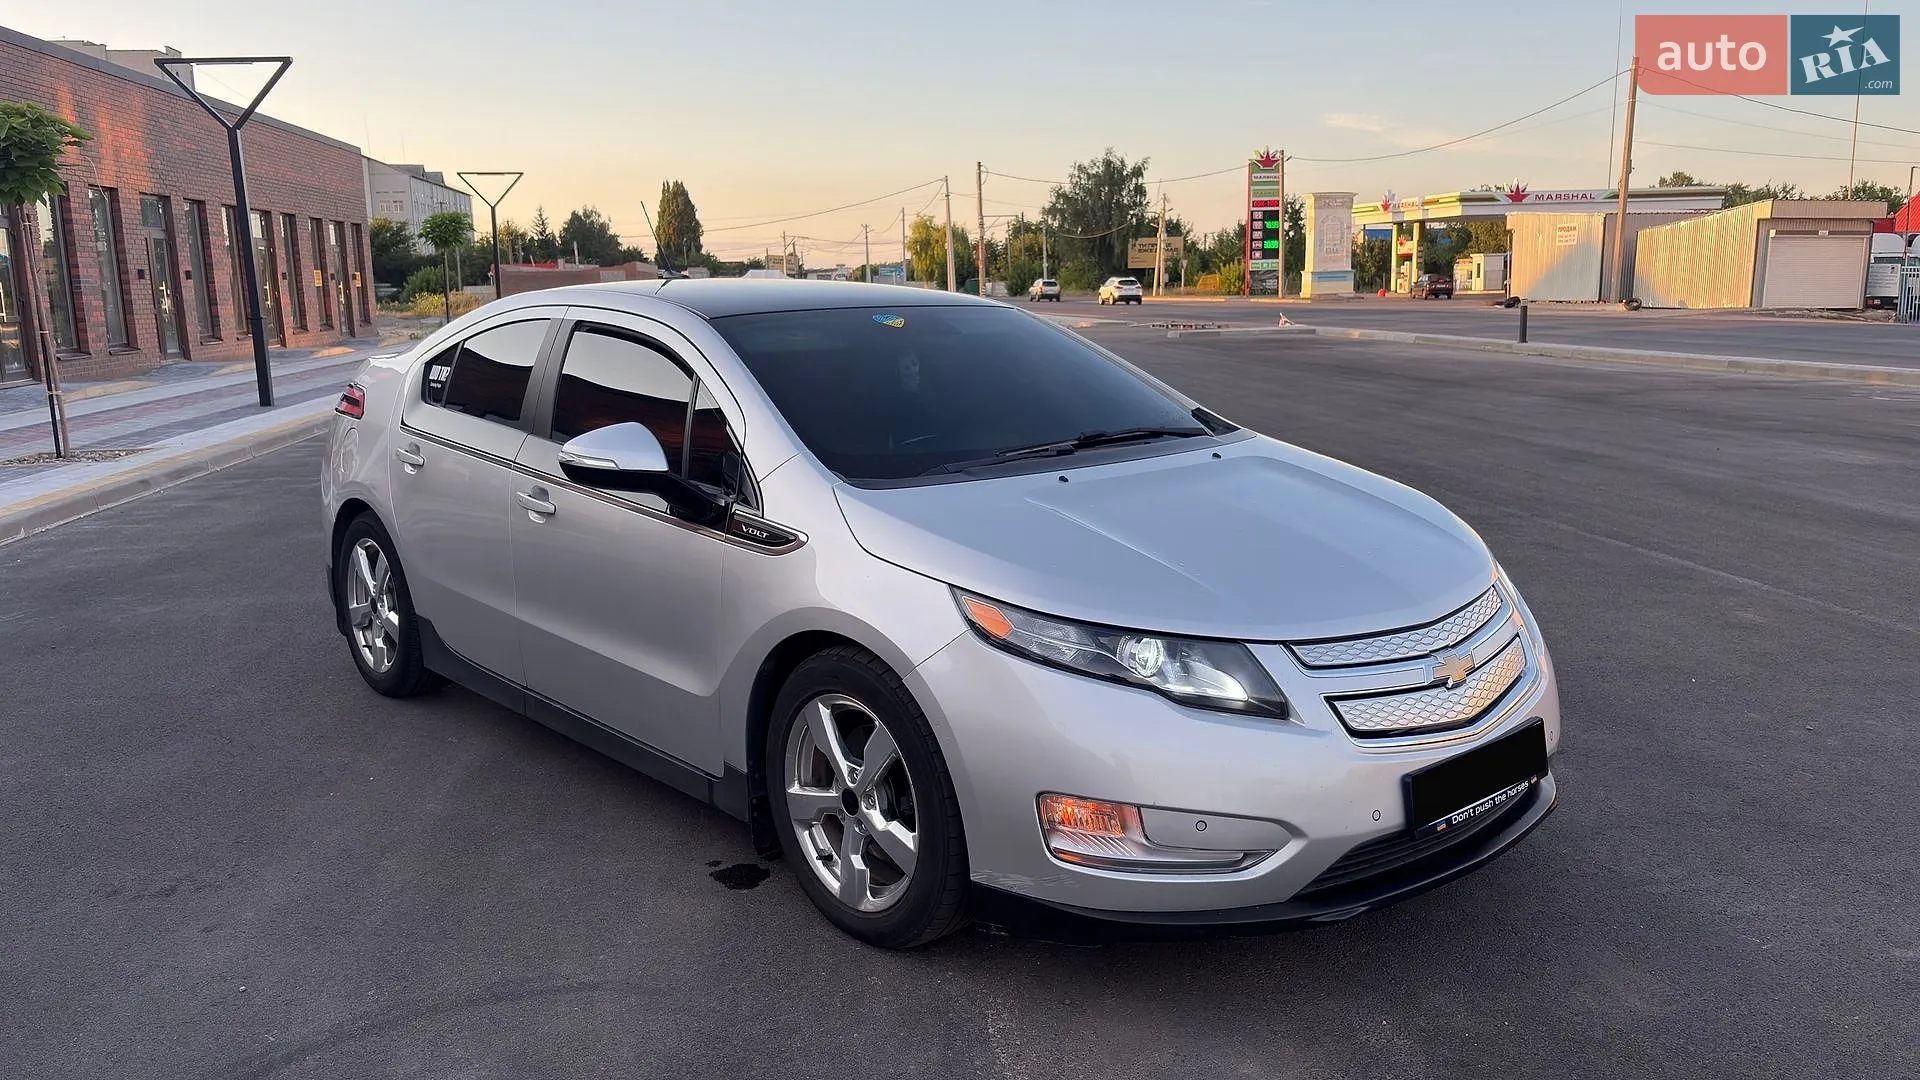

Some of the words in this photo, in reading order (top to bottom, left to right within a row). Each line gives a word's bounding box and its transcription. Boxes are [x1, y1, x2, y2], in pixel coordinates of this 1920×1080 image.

[1534, 192, 1596, 201] MARSHAL
[741, 524, 769, 539] VOLT
[1451, 809, 1474, 825] Don't
[1475, 800, 1494, 816] push
[1495, 793, 1507, 805] the
[1507, 780, 1529, 798] horses
